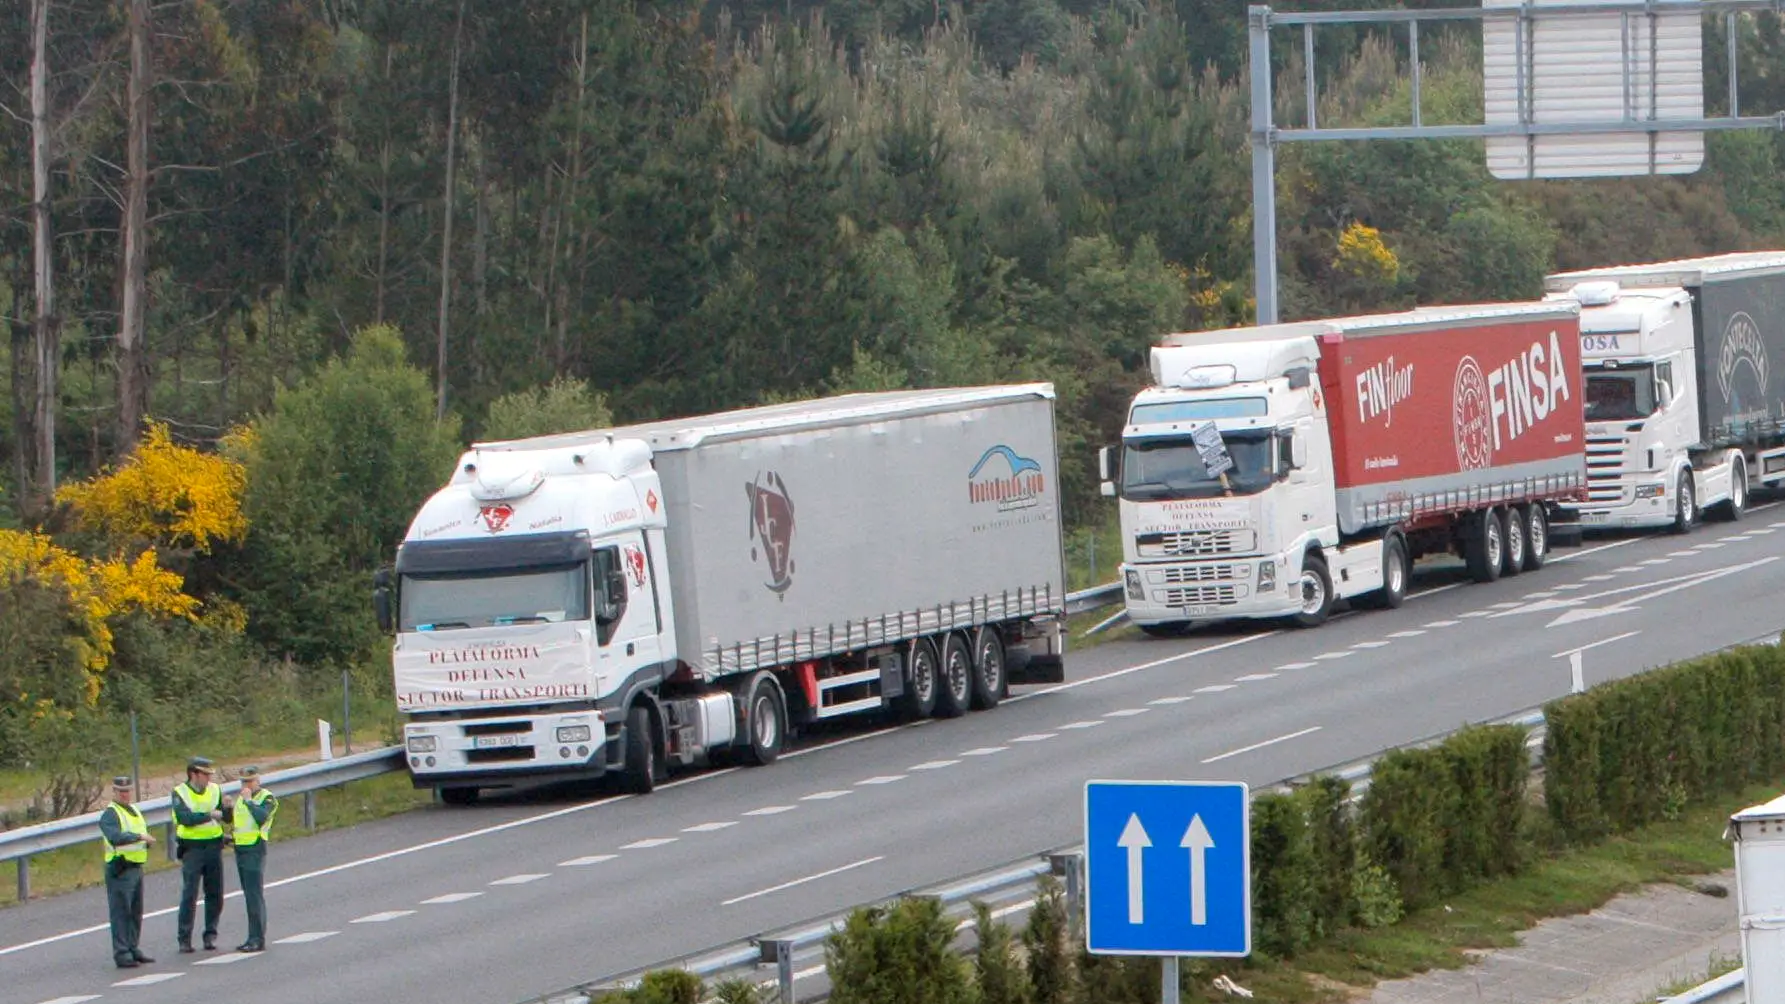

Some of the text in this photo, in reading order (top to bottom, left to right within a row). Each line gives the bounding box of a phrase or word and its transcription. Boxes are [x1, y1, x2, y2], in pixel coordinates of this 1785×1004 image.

[1488, 330, 1569, 450] FINSA
[429, 646, 540, 664] PLATAFORMA
[448, 667, 526, 683] DEFENSA
[398, 683, 589, 704] SECTOR TRANSPORTE
